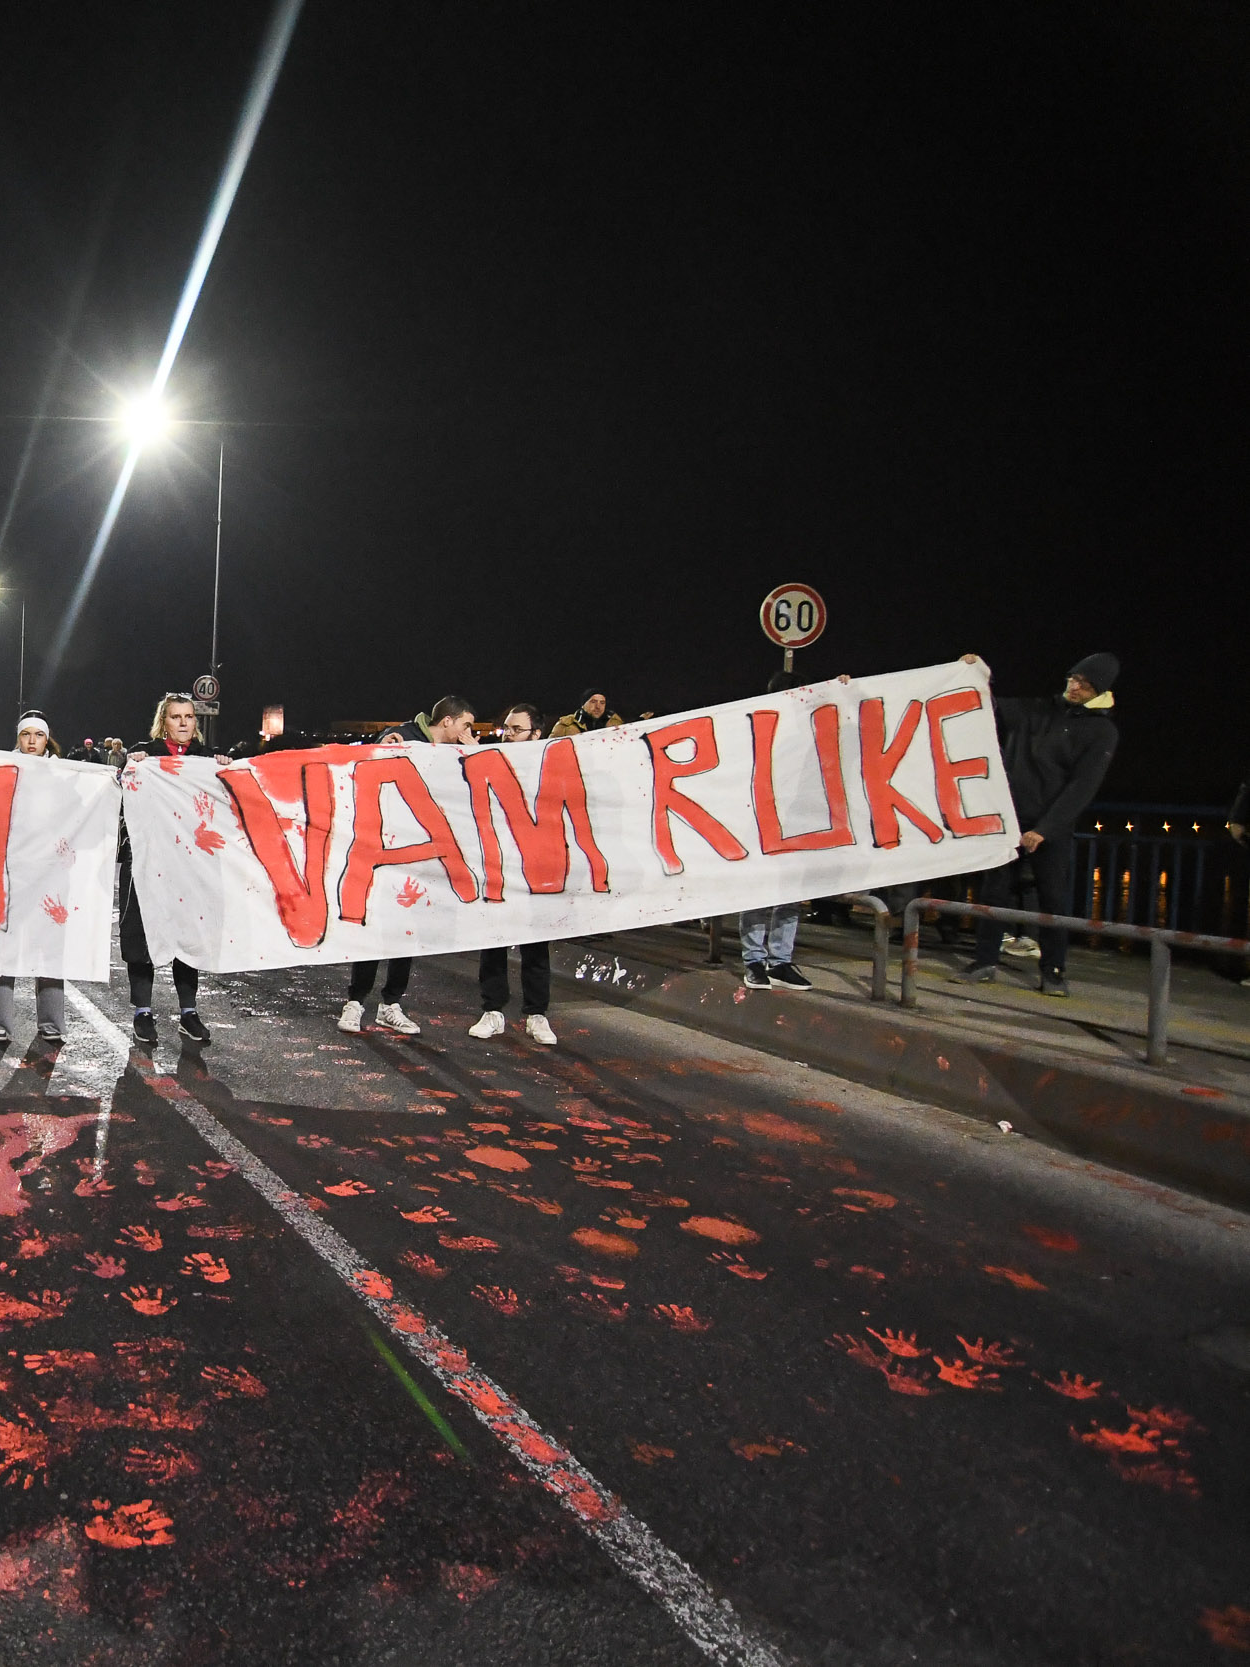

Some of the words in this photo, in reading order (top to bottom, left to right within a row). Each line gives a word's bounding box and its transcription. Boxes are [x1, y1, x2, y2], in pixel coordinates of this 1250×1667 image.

[775, 599, 813, 632] 60
[199, 682, 215, 695] 40
[216, 737, 610, 948] VAM
[640, 687, 1006, 876] RUKE
